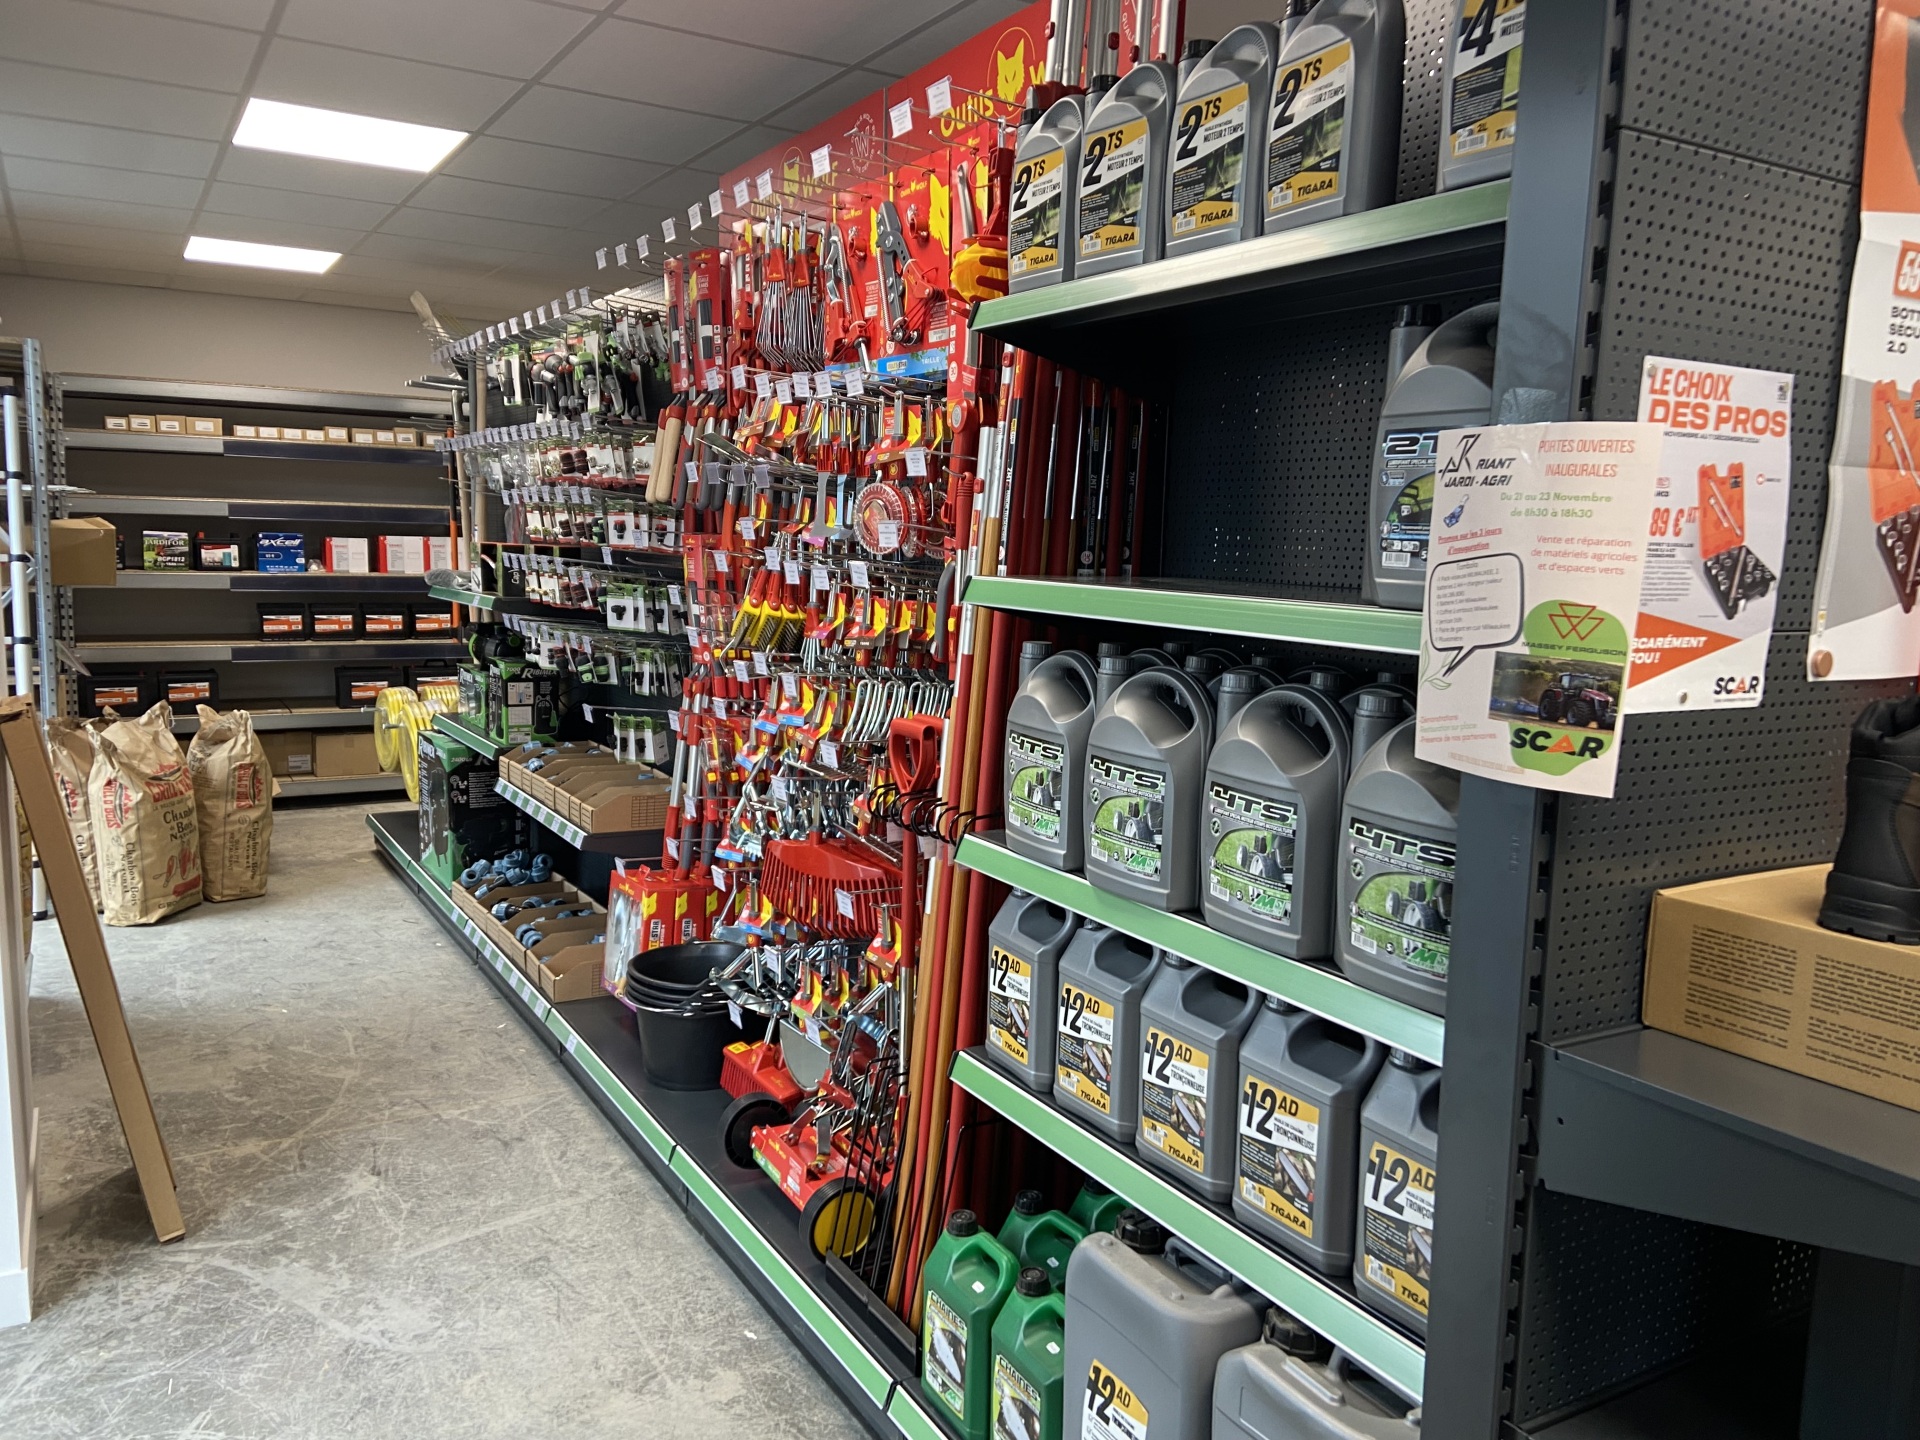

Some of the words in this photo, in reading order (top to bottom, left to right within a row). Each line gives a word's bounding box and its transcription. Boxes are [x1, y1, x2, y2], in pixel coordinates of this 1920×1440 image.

[1327, 84, 1345, 100] TEMPS
[1204, 129, 1223, 143] MOTEUR
[1227, 122, 1244, 135] TEMPS
[1107, 159, 1124, 172] MOTEUR
[1128, 153, 1144, 166] TEMPS
[1297, 178, 1333, 197] TIGARA
[1200, 208, 1234, 224] TIGARA
[1105, 232, 1135, 246] TIGARA
[1030, 253, 1054, 266] TIGARA
[1887, 341, 1907, 354] 2.0
[1648, 366, 1673, 396] LE
[1673, 369, 1733, 401] CHOIX
[1648, 398, 1710, 430] DES
[1714, 404, 1787, 438] PROS
[1538, 439, 1575, 454] PORTES
[1577, 439, 1635, 454] OUVERTES
[1545, 463, 1618, 478] INAUGURALES
[1500, 492, 1513, 501] Du
[1514, 492, 1523, 501] 21
[1525, 493, 1538, 501] au
[1539, 492, 1550, 501] 23
[1554, 492, 1612, 503] Novembre
[1510, 508, 1523, 517] de
[1524, 508, 1548, 517] 8h30
[1550, 508, 1558, 518] à
[1561, 508, 1593, 518] 18h30
[1649, 507, 1670, 537] 89
[1537, 536, 1562, 545] Vente
[1564, 536, 1575, 545] et
[1576, 536, 1632, 549] réparation
[1531, 549, 1543, 557] de
[1544, 549, 1589, 560] matériels
[1590, 552, 1638, 565] agricoles
[1537, 562, 1548, 571] et
[1549, 562, 1597, 575] d'espaces
[1598, 566, 1626, 575] verts
[1521, 641, 1564, 651] MASSEY
[1565, 645, 1627, 656] FERGUSON
[1631, 634, 1708, 649] SCARÉMENT
[1714, 676, 1760, 695] SCAR
[1010, 733, 1061, 761] 4TS
[1509, 727, 1605, 759] SCAR
[1091, 759, 1163, 790] 4TS
[1212, 785, 1294, 824] 4TS
[1352, 823, 1457, 867] 4TS
[1081, 1021, 1111, 1041] TRONÇONNEUSE
[1004, 1040, 1025, 1059] TIGARA
[1171, 1069, 1205, 1095] TRONÇONNEUSE
[1080, 1089, 1107, 1110] TIGARA
[1273, 1122, 1315, 1152] TRONÇONNEUSE
[1168, 1144, 1199, 1168] TIGARA
[1270, 1202, 1307, 1230] TIGARA
